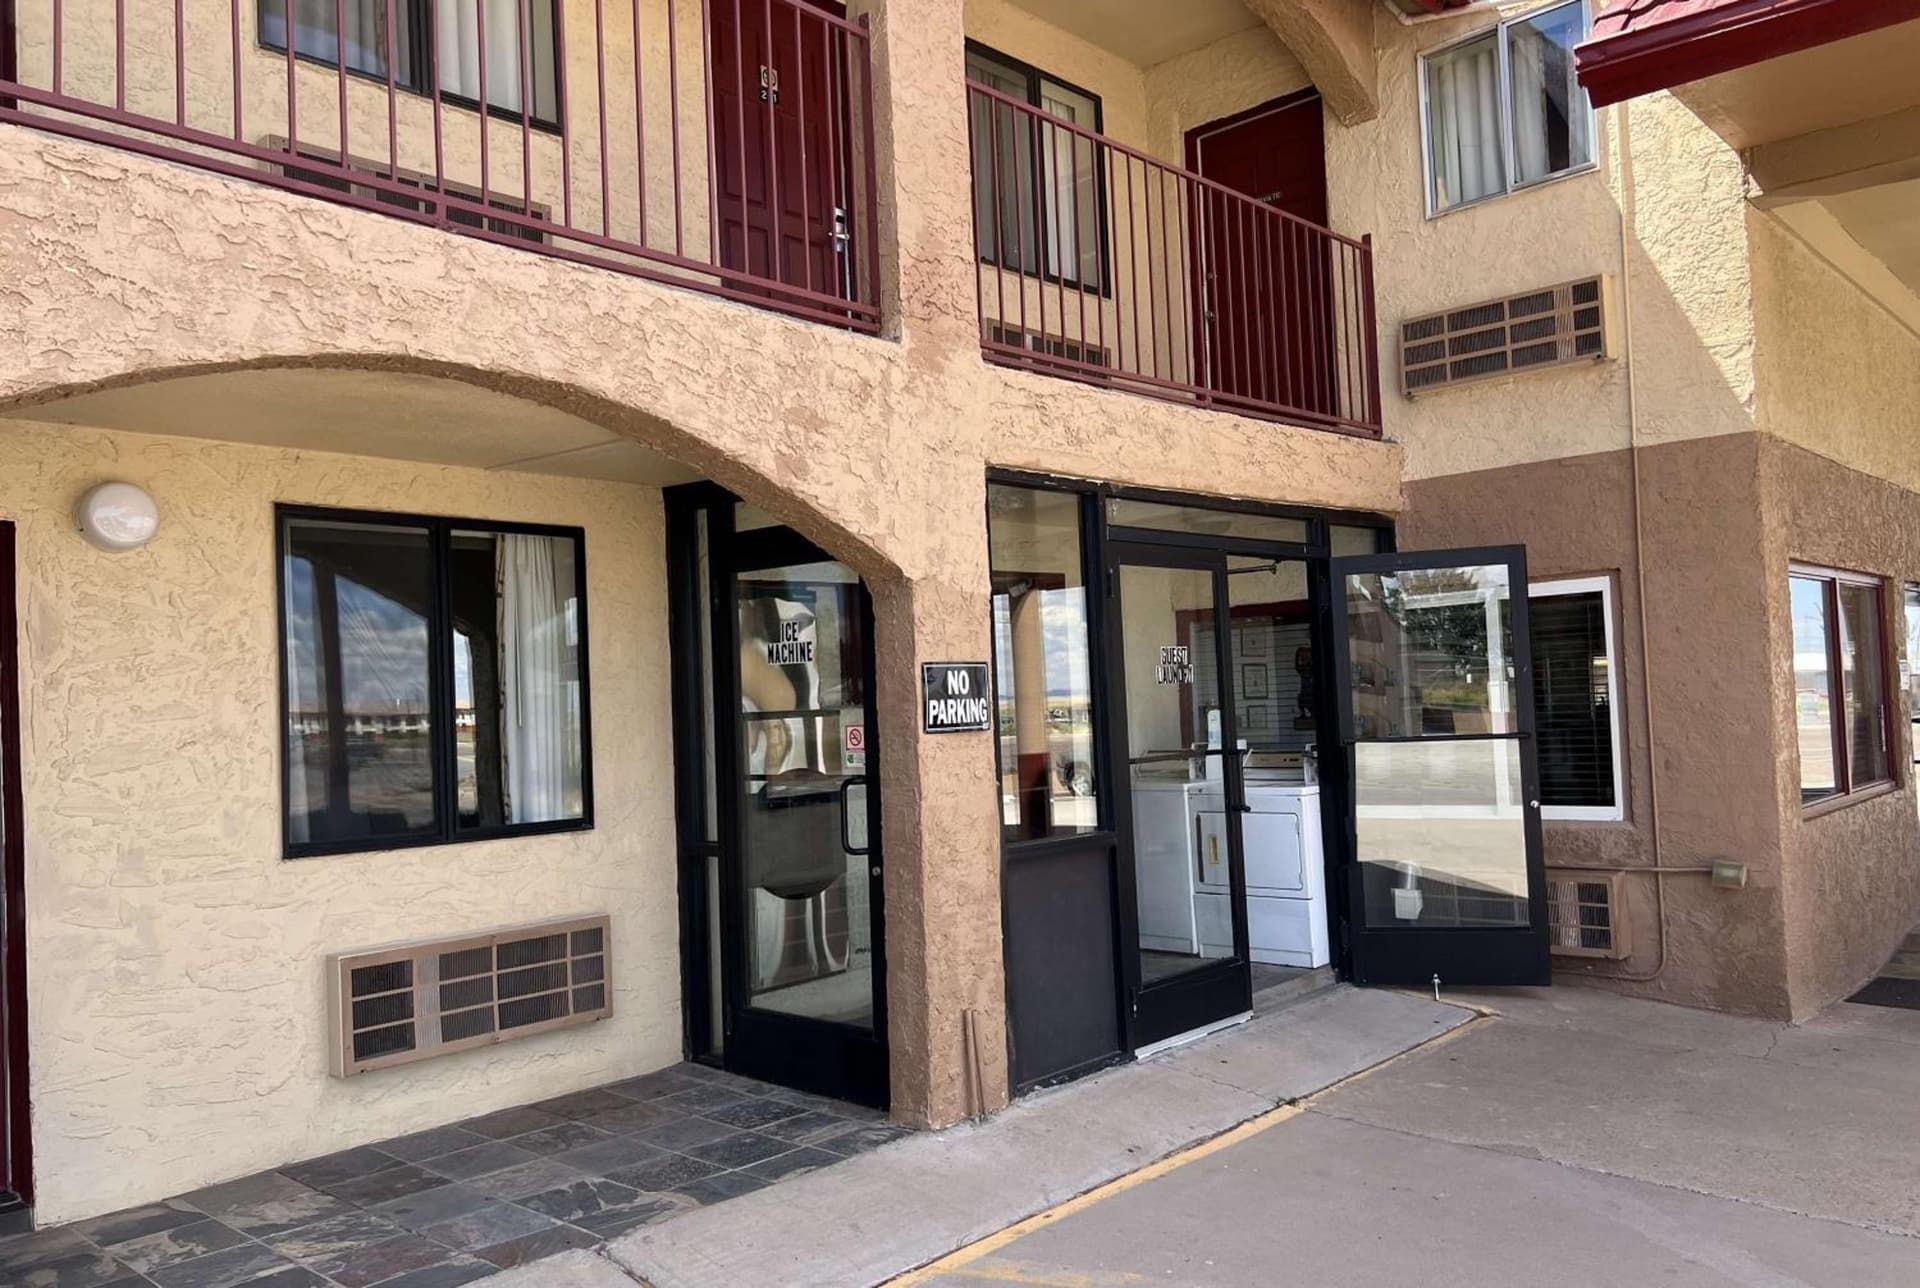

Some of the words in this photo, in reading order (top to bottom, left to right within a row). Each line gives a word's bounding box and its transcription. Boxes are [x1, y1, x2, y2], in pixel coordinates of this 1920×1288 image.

[760, 89, 777, 103] 21
[780, 621, 799, 642] ICE
[767, 641, 813, 665] MACHINE
[1161, 646, 1188, 665] GUEST
[947, 670, 970, 695] NO
[928, 698, 988, 725] PARKING
